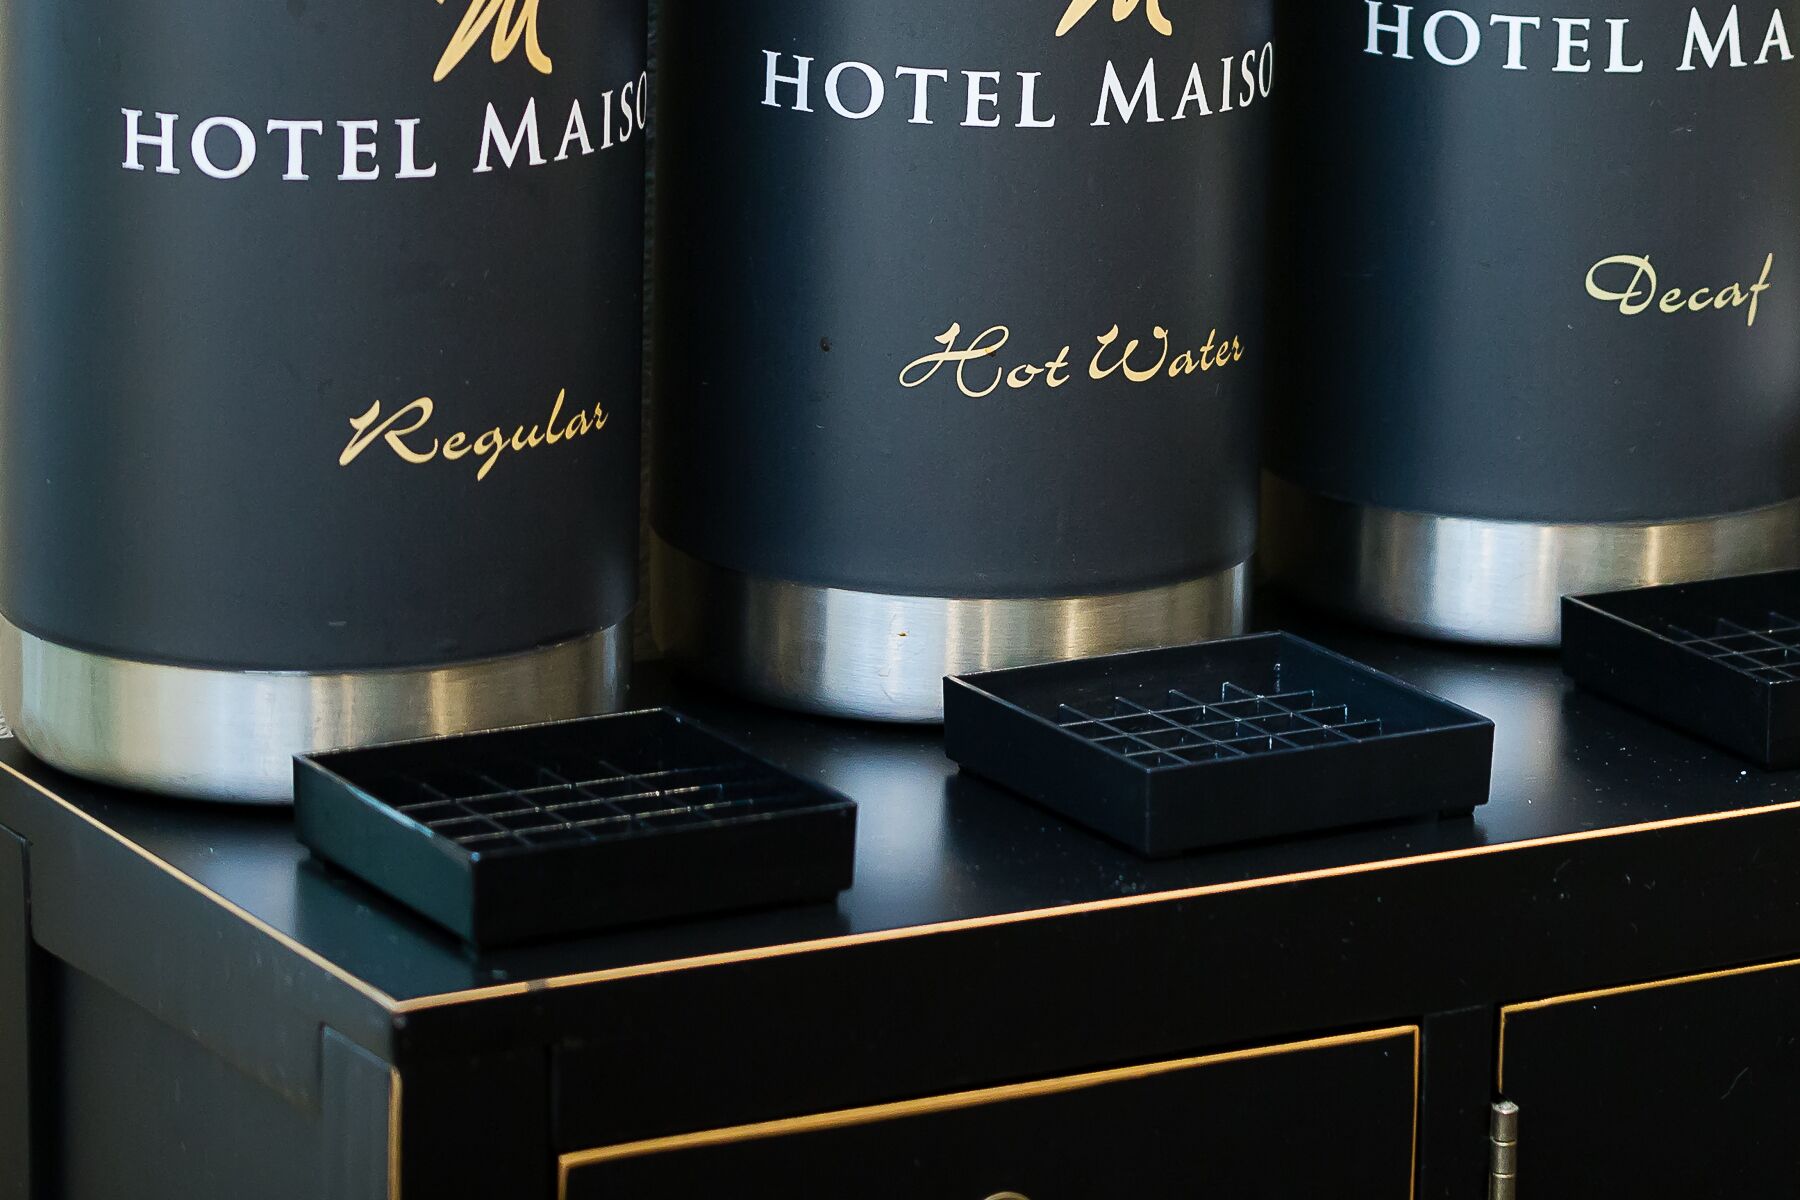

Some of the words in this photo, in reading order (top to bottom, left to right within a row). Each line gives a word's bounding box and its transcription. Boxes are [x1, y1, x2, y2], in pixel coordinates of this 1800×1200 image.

[1363, 0, 1644, 73] HOTEL
[760, 49, 1056, 128] HOTEL
[120, 107, 437, 181] HOTEL
[1585, 252, 1773, 327] Decaf
[898, 322, 1070, 398] Hot
[1088, 323, 1243, 382] Water
[338, 388, 607, 481] Regular
